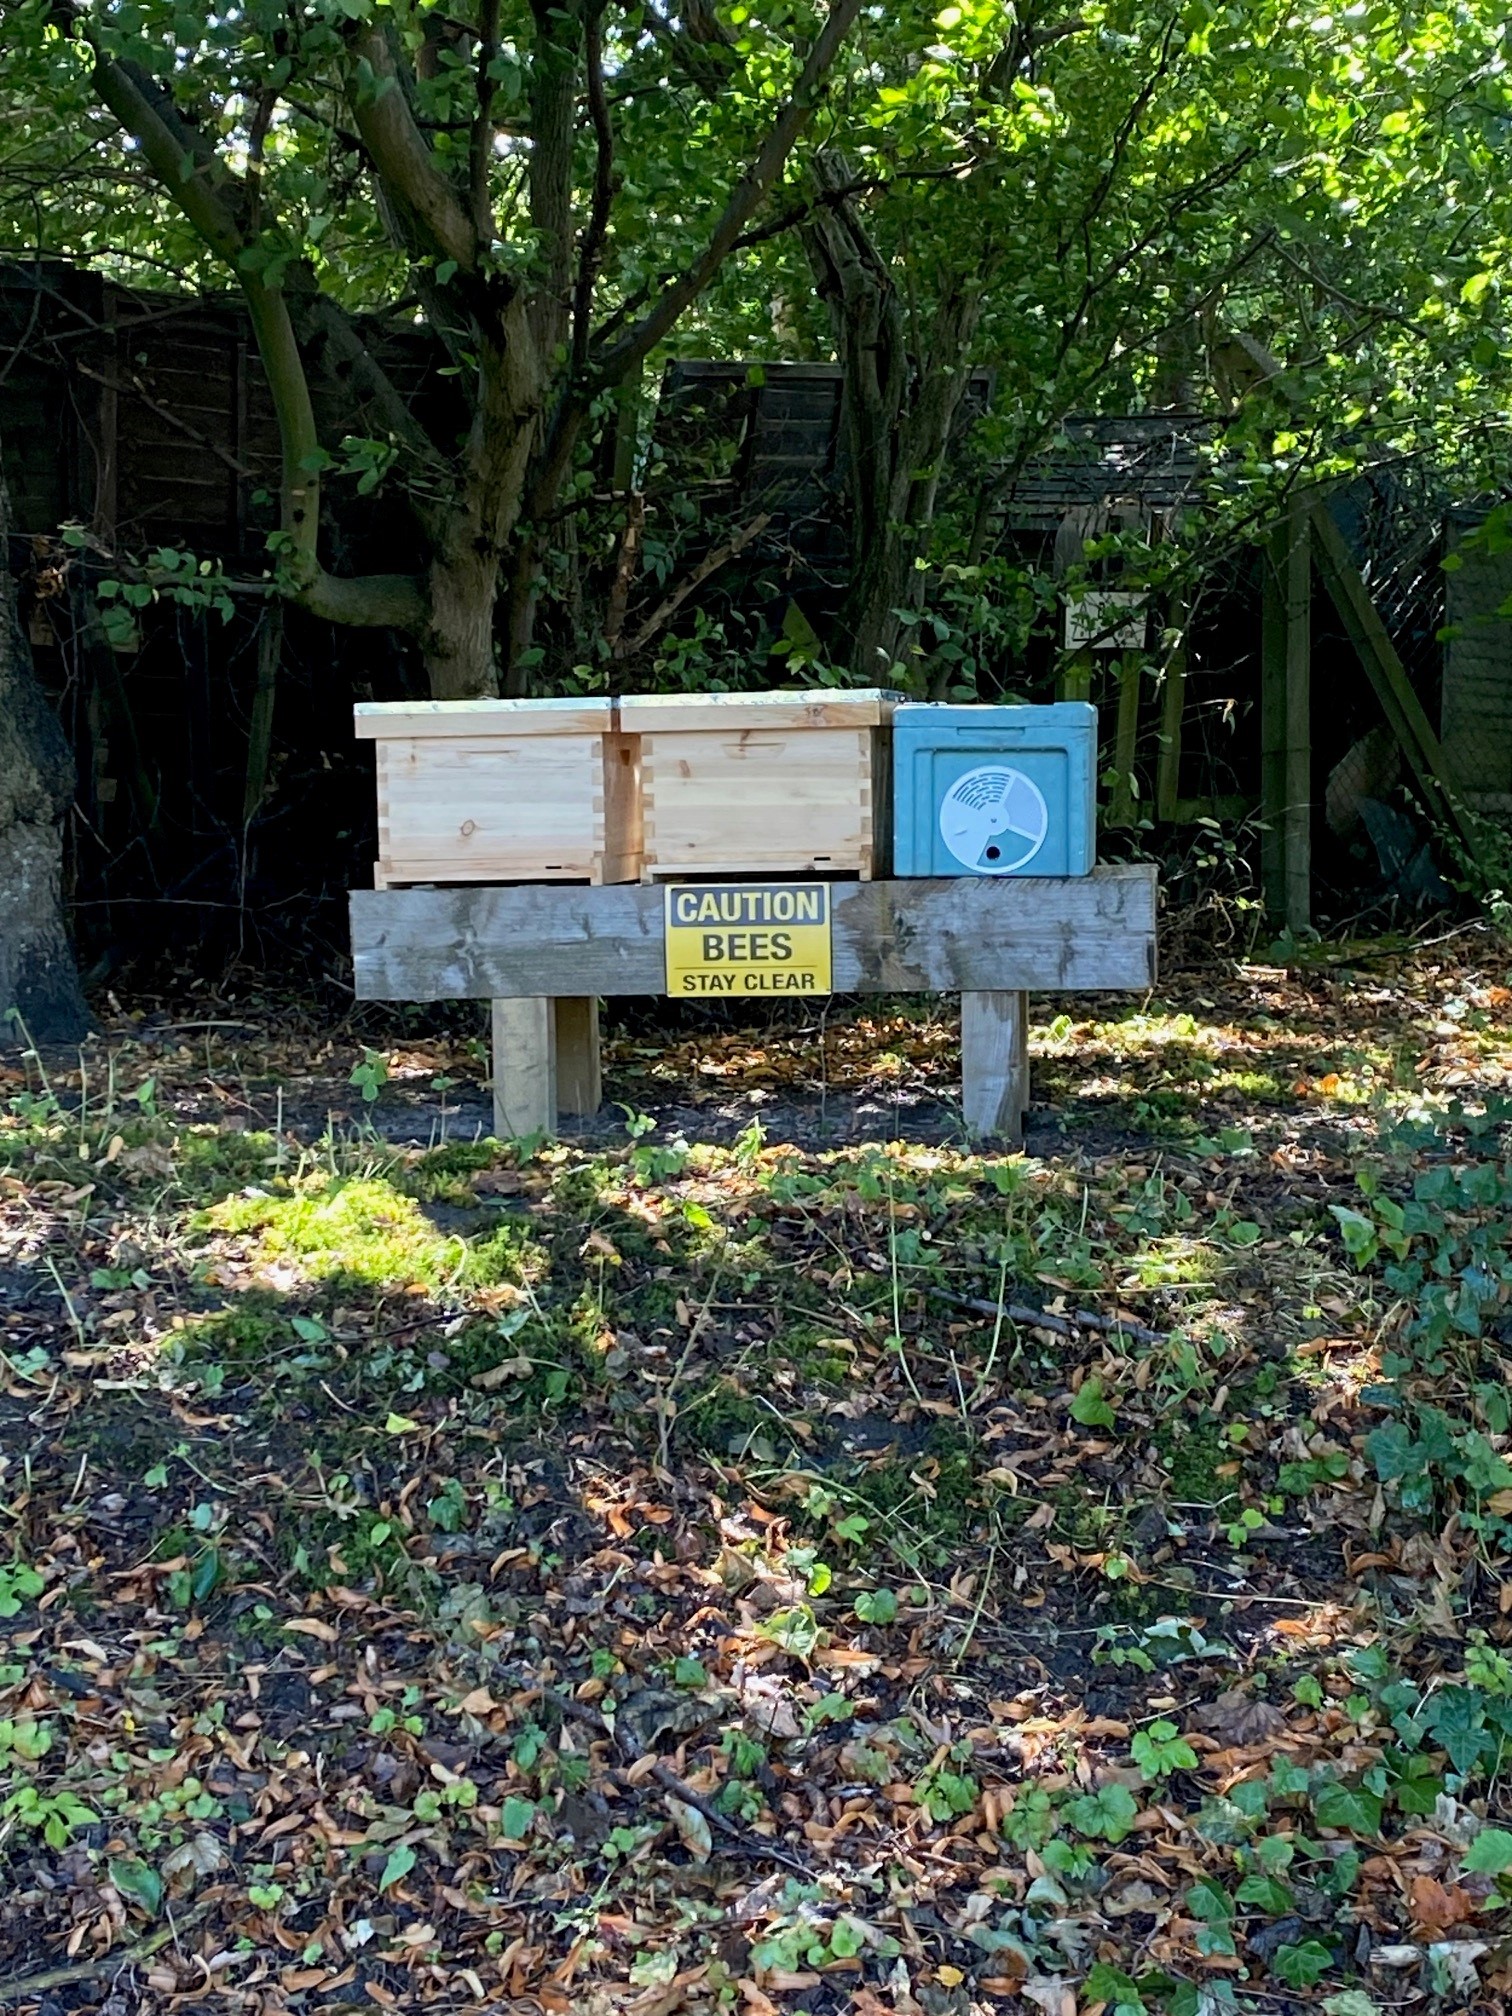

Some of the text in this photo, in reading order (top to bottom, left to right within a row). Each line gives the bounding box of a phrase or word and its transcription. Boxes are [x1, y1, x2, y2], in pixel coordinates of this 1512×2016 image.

[676, 891, 819, 922] CAUTION
[703, 932, 793, 961] BEES
[683, 973, 815, 991] STAY CLEAR
